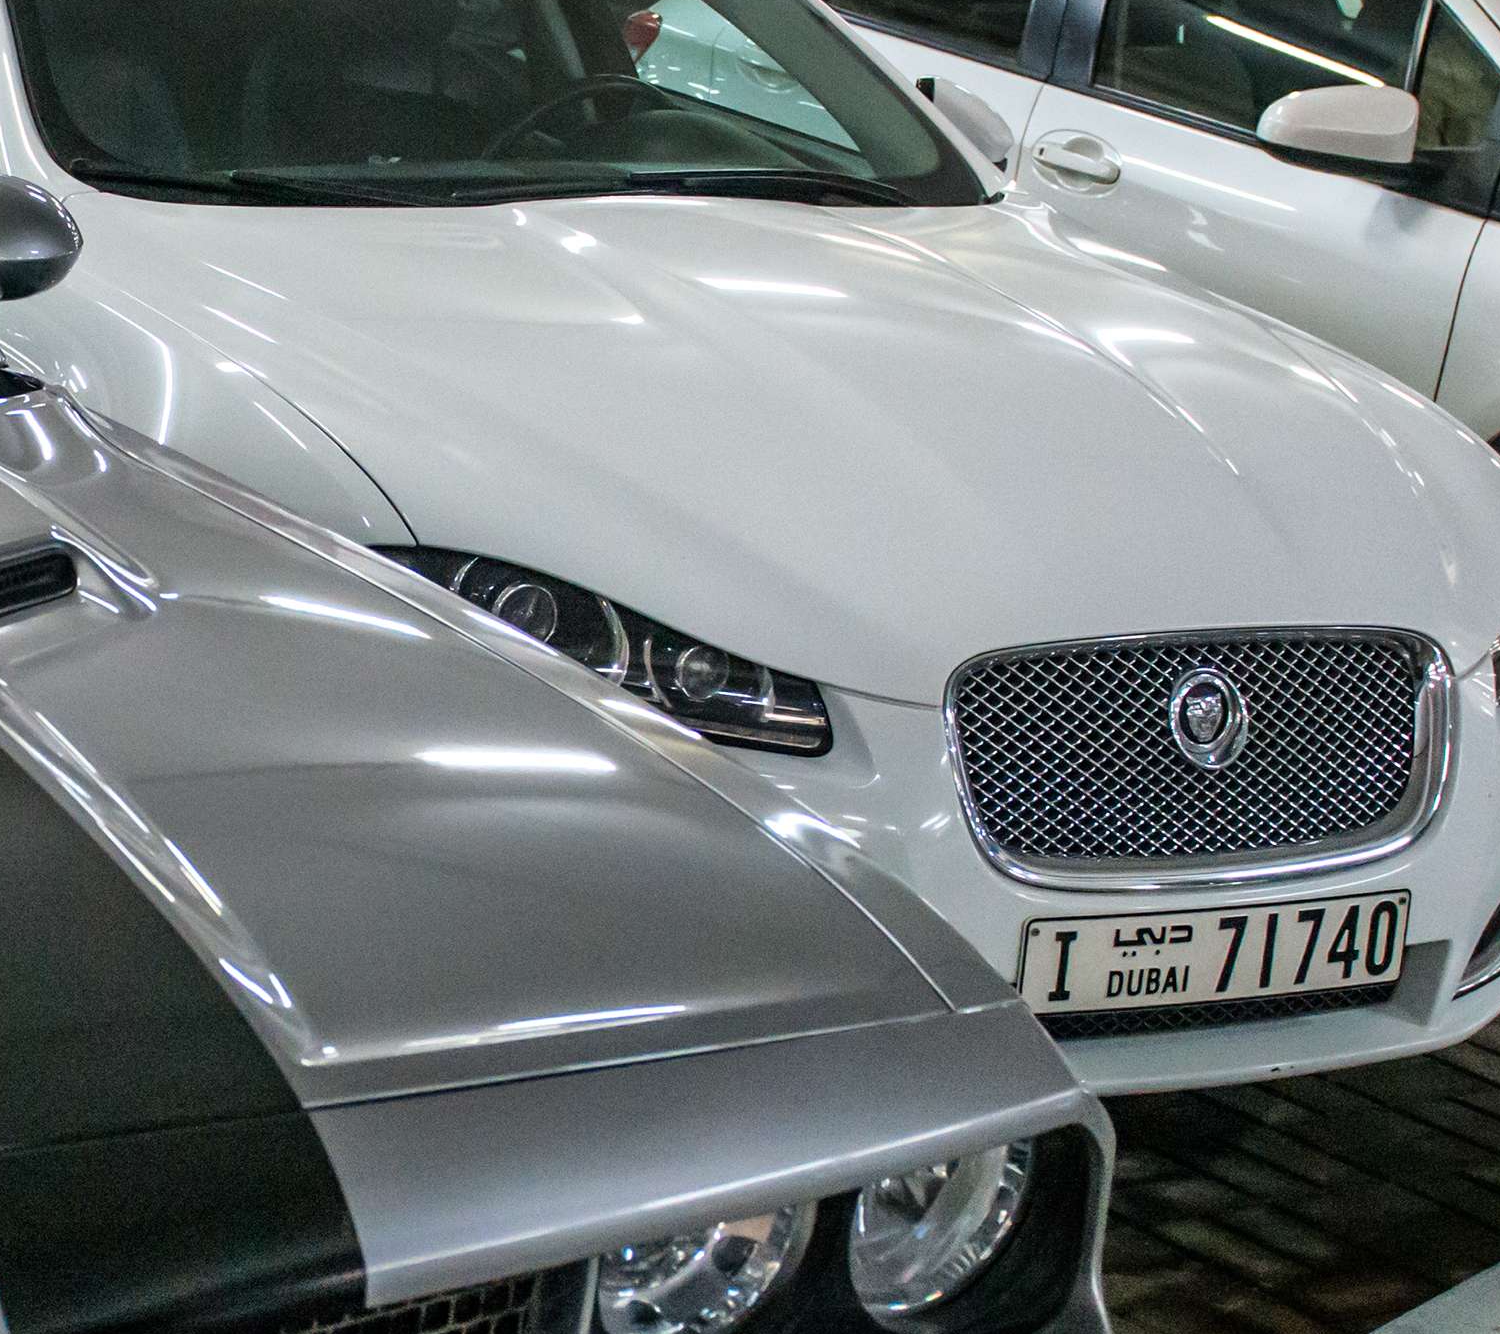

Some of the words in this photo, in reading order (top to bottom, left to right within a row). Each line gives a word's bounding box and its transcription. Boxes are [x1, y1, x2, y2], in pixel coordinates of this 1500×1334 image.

[1048, 931, 1078, 1002] I
[1215, 900, 1399, 993] 71740
[1113, 924, 1193, 958] دبي
[1106, 965, 1189, 998] DUBAI
